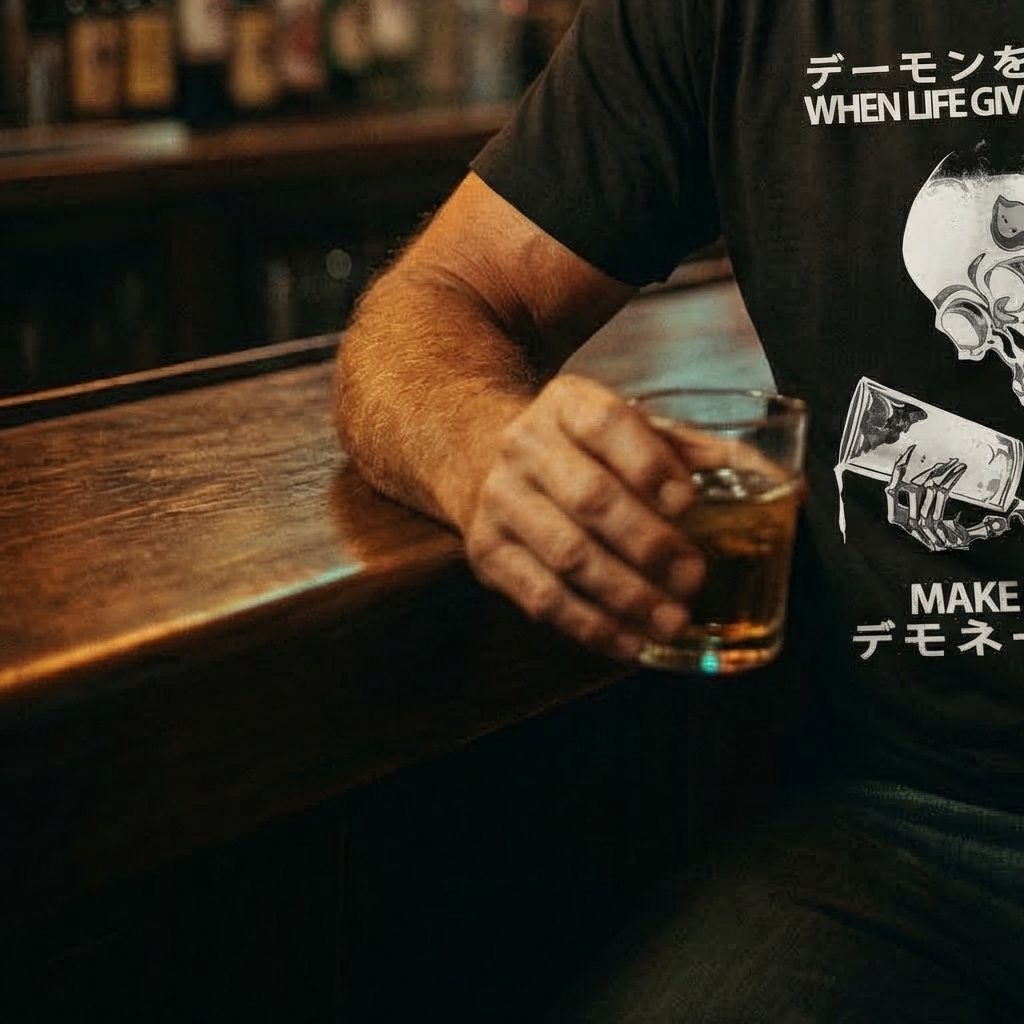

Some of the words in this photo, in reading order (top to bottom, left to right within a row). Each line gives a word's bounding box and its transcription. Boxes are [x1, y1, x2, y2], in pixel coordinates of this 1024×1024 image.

[804, 92, 901, 126] WHEN
[908, 87, 968, 120] LIFE
[911, 581, 1021, 615] MAKE
